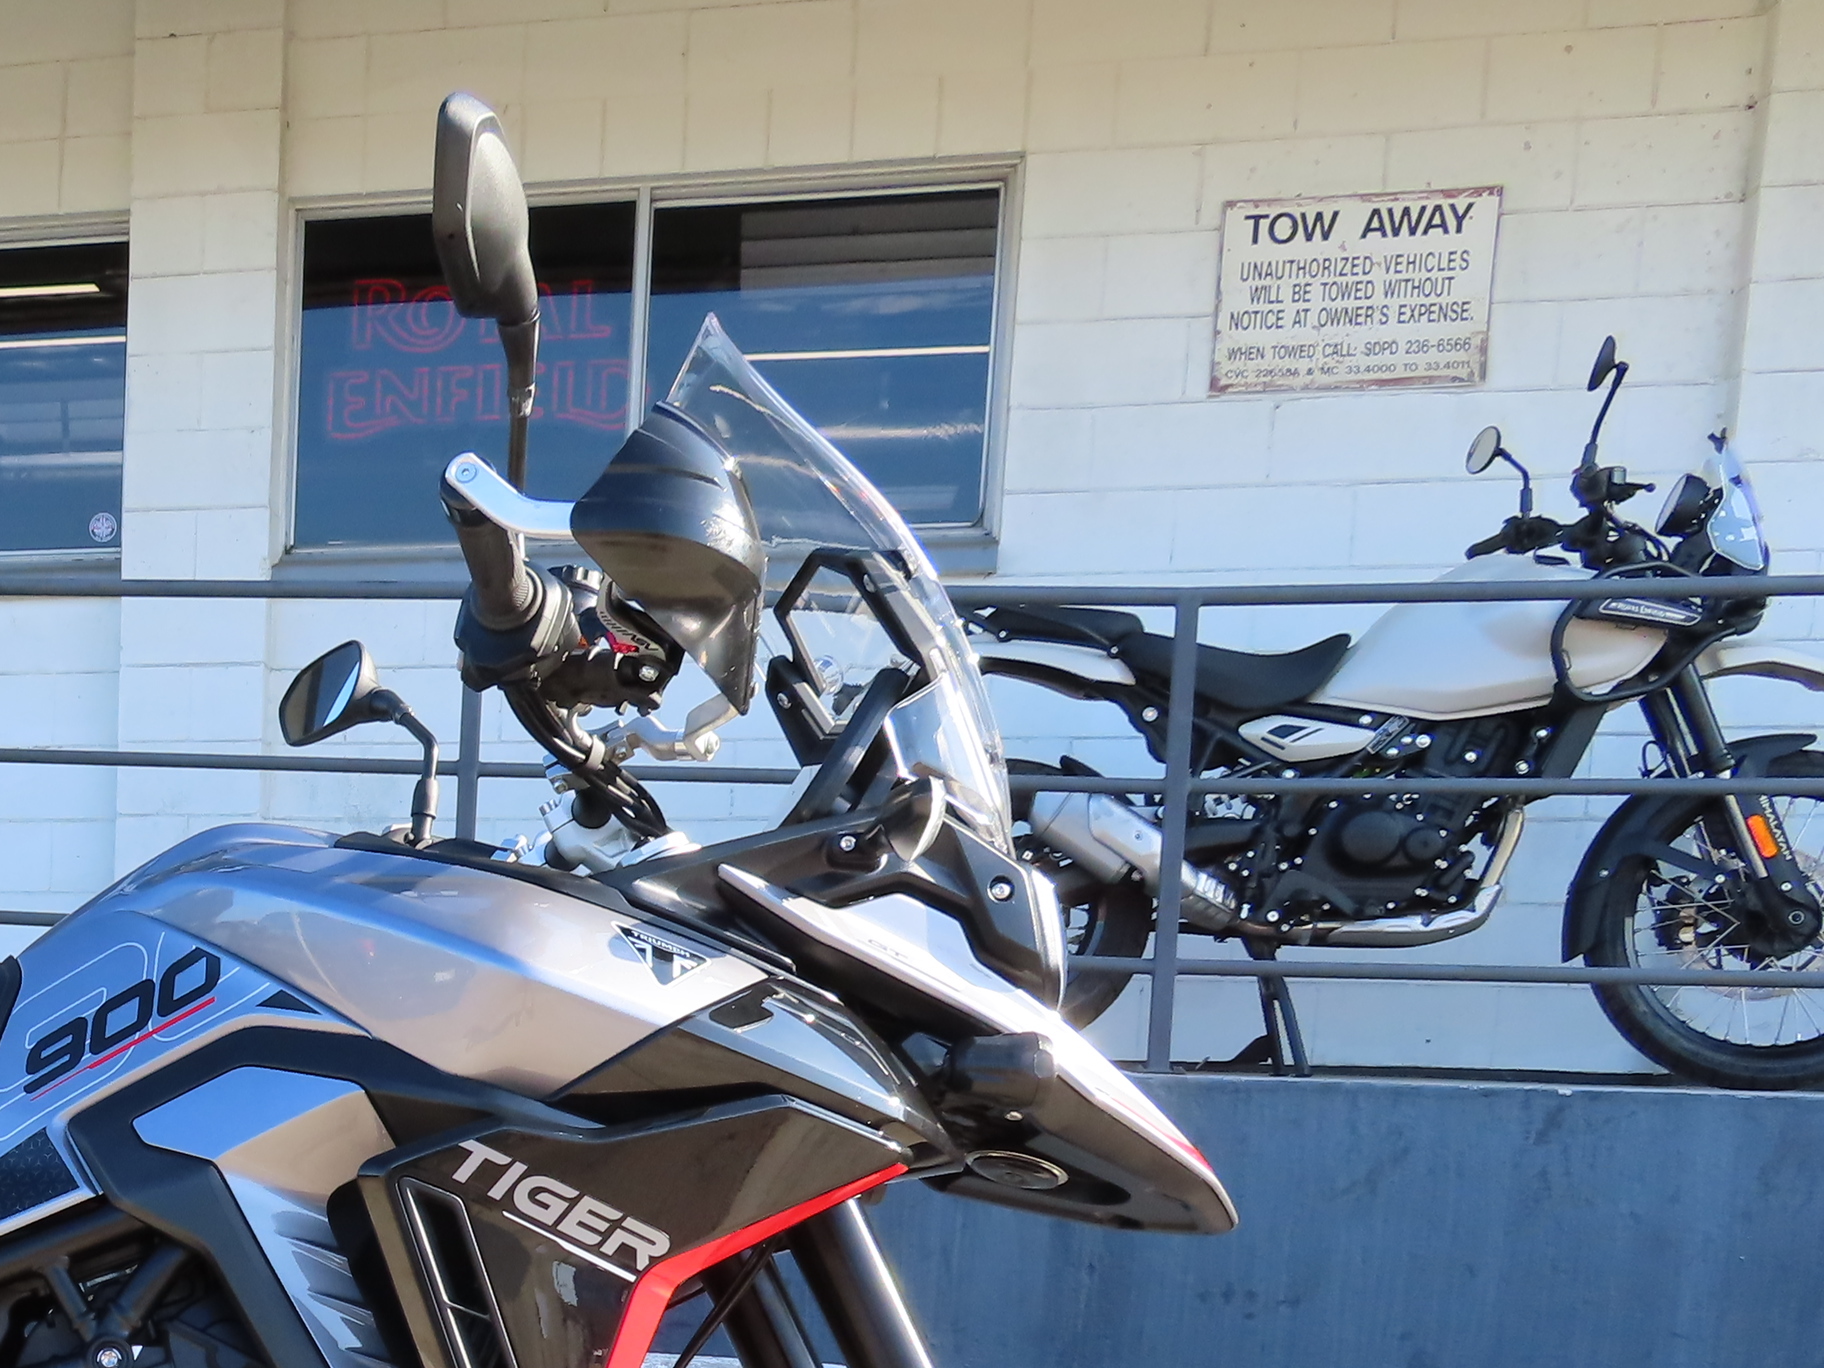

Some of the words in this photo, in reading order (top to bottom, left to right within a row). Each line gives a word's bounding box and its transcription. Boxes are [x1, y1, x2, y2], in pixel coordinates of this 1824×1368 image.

[1244, 210, 1340, 245] TOW
[1360, 202, 1475, 240] AWAY
[1240, 255, 1373, 282] UNAUTHORIZED
[1383, 250, 1470, 275] VEHICLES
[1250, 285, 1284, 305] WILL
[1292, 283, 1312, 302] BE
[1320, 280, 1374, 301] TOWED
[1383, 276, 1455, 298] WITHOUT
[1229, 309, 1285, 331] NOTICE
[1292, 308, 1310, 328] AT
[1318, 304, 1390, 328] OWNER'S
[1397, 301, 1474, 324] EXPENSE.
[1227, 346, 1265, 361] WHEN
[1271, 344, 1315, 360] TOWED
[1364, 341, 1399, 357] SDPD
[1405, 337, 1472, 355] 236-6566
[1403, 362, 1418, 372] TO
[631, 930, 691, 958] TRIUMPH
[24, 947, 221, 1094] 900
[451, 1139, 671, 1271] TIGER
